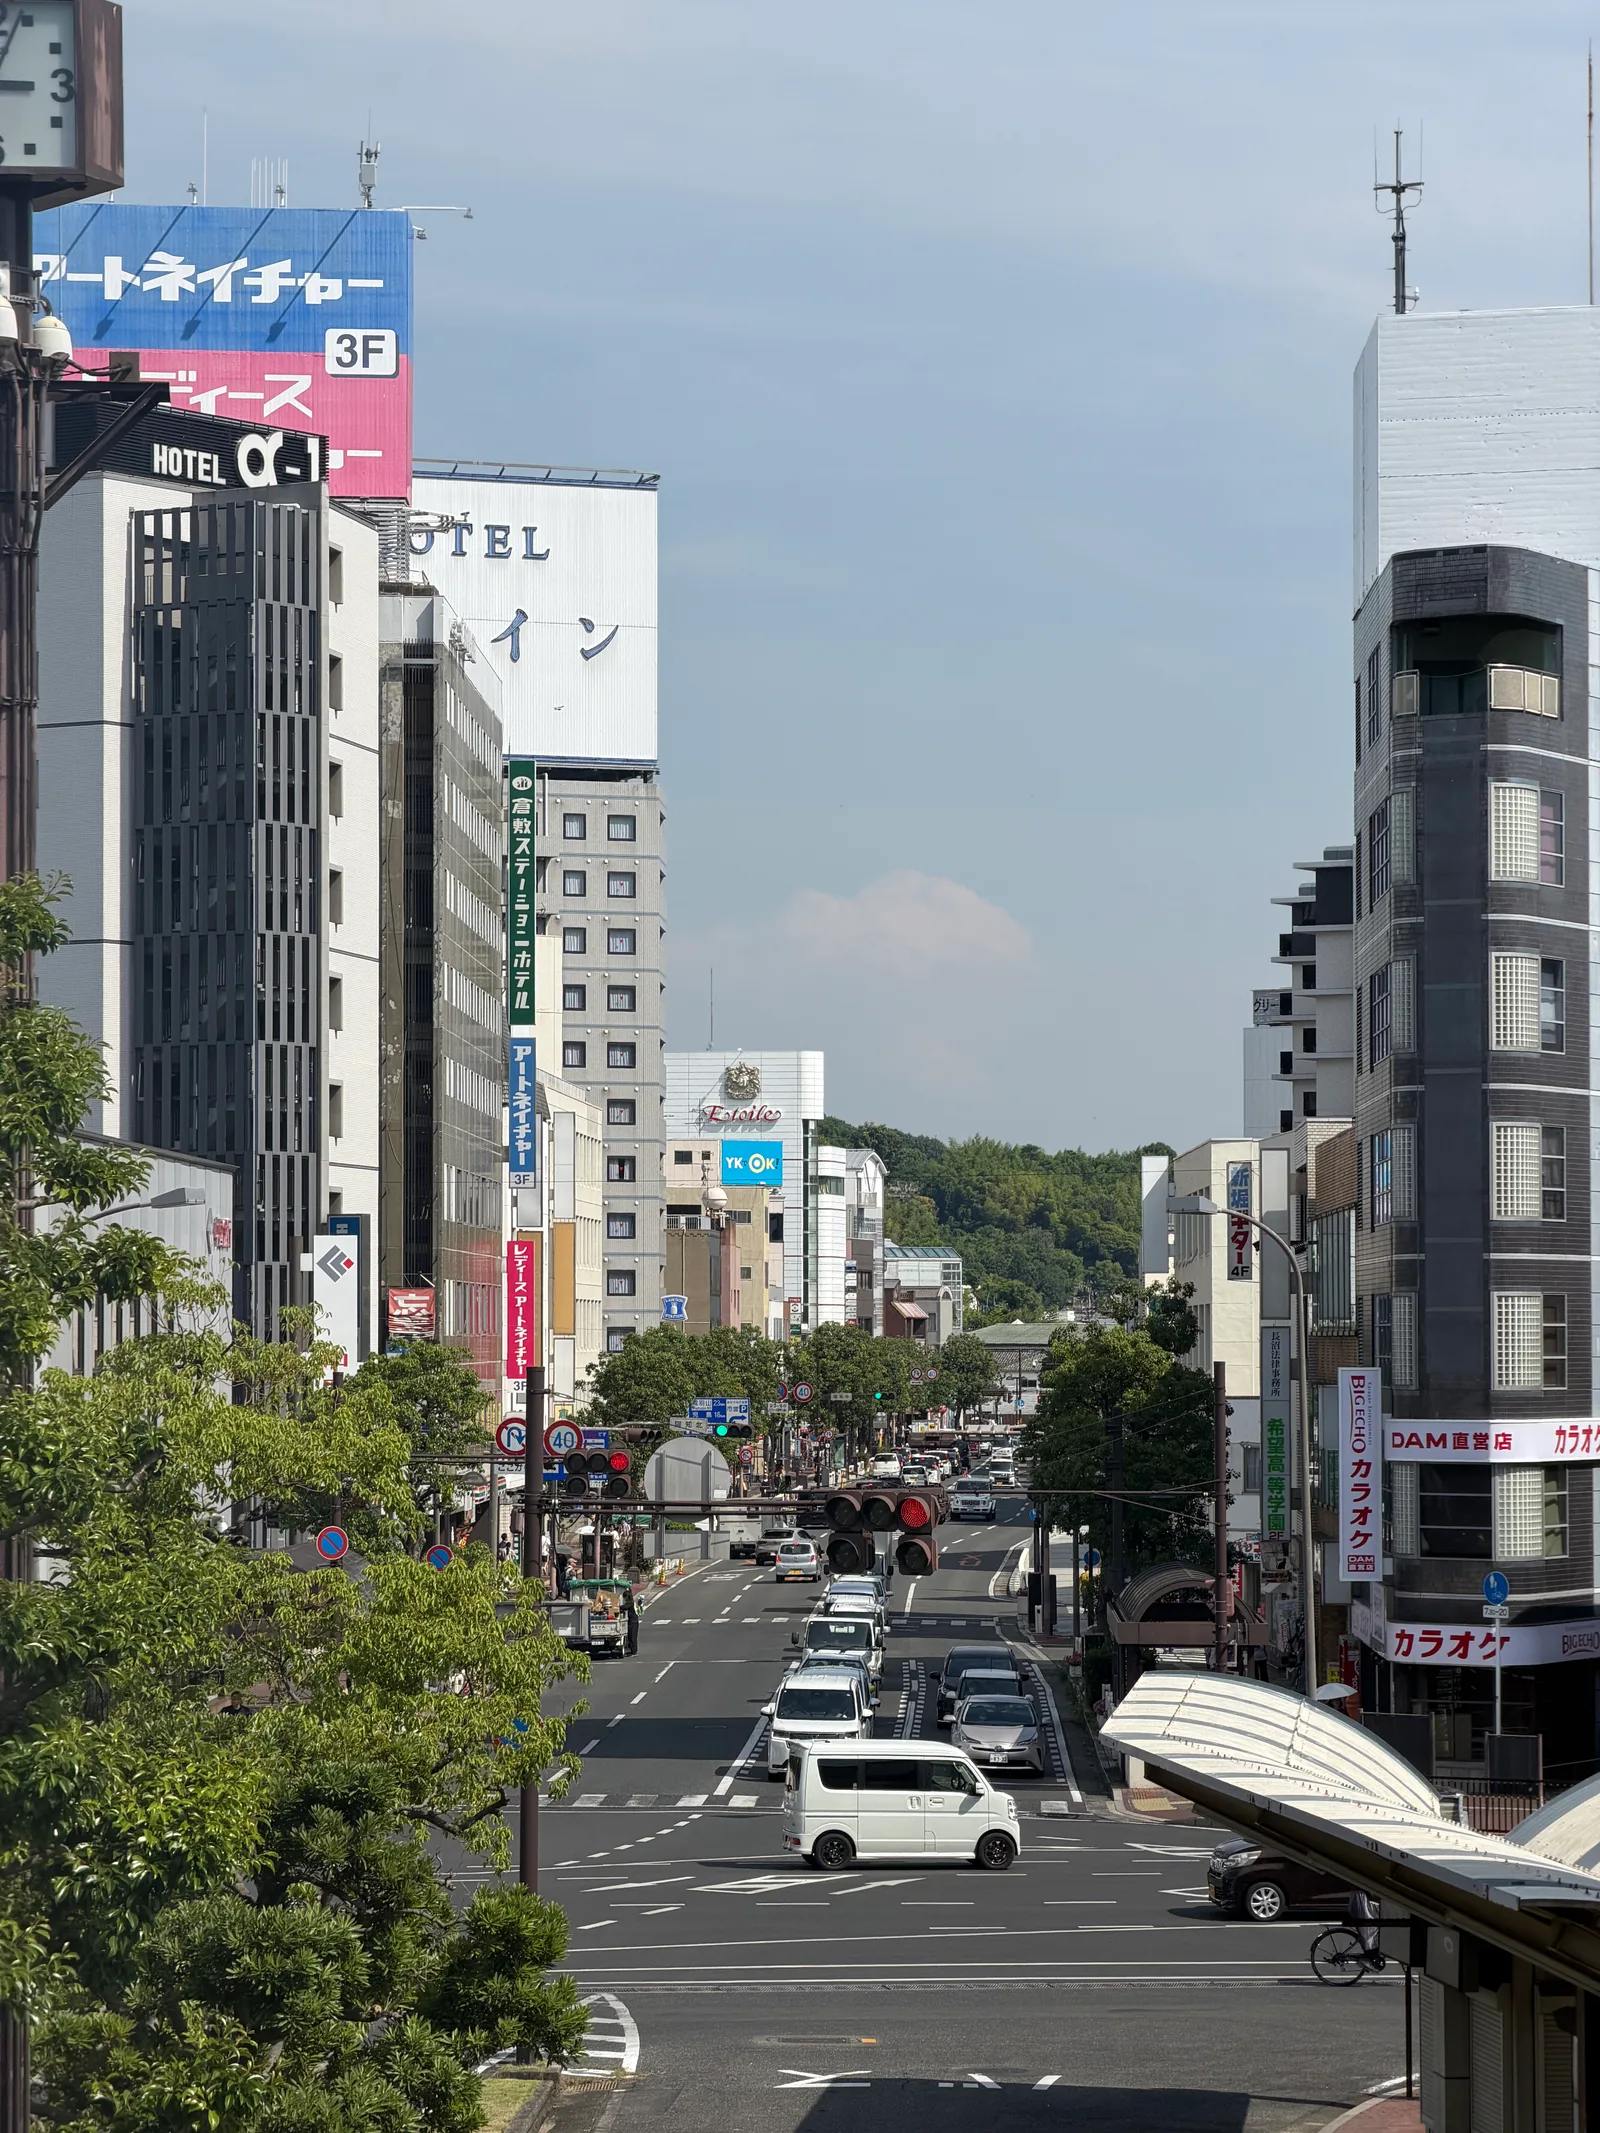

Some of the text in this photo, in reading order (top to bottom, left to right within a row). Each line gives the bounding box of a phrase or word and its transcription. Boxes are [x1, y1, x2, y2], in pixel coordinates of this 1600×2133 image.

[50, 68, 75, 102] 3
[32, 251, 384, 305] アートネイチャー
[335, 334, 386, 369] 3F
[82, 370, 313, 418] ディース
[153, 443, 227, 485] HOTEL
[511, 797, 533, 1010] 倉敷ステーションホテル
[513, 1045, 532, 1166] アートネイチャー
[702, 1105, 781, 1124] Etoile
[514, 1174, 531, 1185] 3F
[1230, 1167, 1250, 1265] 新堀ギター
[1230, 1266, 1250, 1277] 4F
[514, 1244, 528, 1375] レディース アートネイチャー
[1271, 1331, 1281, 1397] 長沼法律事務所
[798, 1387, 810, 1397] 40
[1350, 1375, 1366, 1454] BIG ECHO
[553, 1431, 575, 1449] 40
[1267, 1418, 1286, 1532] 希望高等学園
[1350, 1459, 1373, 1549] カラオケ
[1269, 1532, 1285, 1541] 2F
[1348, 1555, 1375, 1563] DAM
[1394, 1629, 1511, 1660] カラオケ
